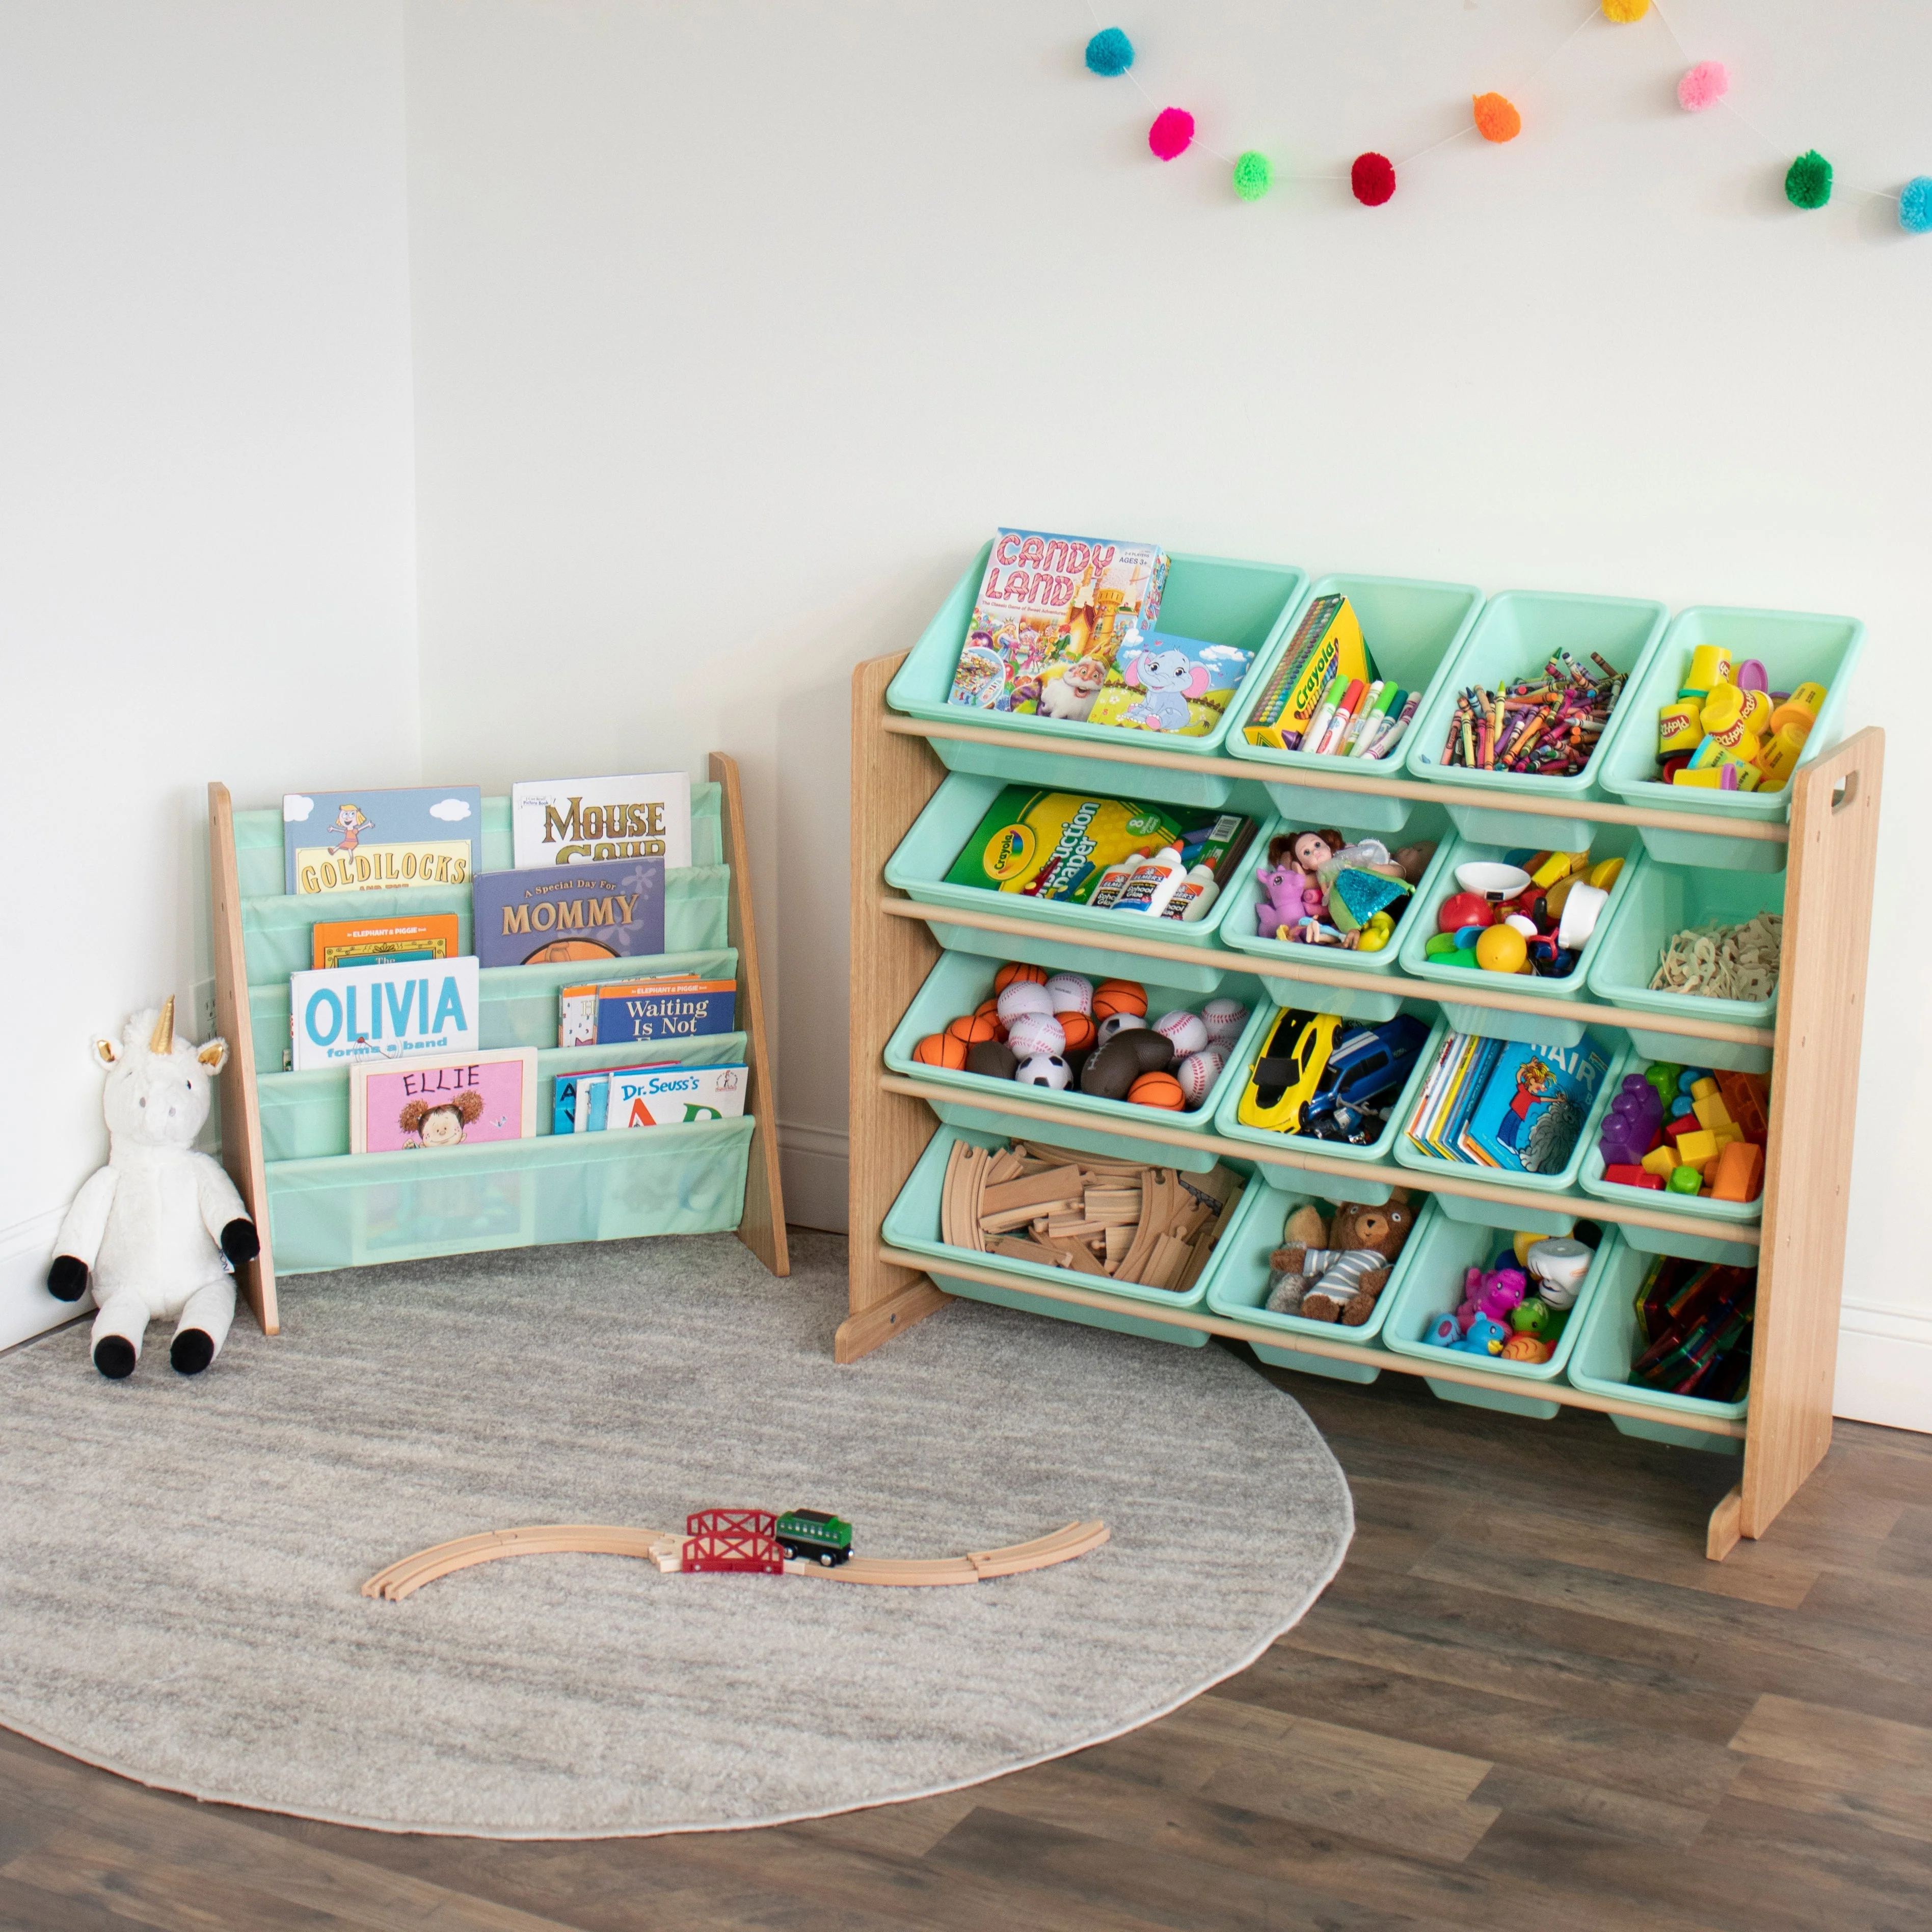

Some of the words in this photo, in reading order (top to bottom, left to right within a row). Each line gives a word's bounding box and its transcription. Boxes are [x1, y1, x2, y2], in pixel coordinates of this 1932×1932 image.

[996, 534, 1115, 577] CANDY
[985, 567, 1075, 607] LAND
[1296, 640, 1334, 710] Crayola
[1711, 721, 1745, 746] Play-Do
[542, 796, 666, 844] MOUSE
[1129, 819, 1144, 828] 8
[994, 834, 1013, 870] Crayola
[1054, 836, 1097, 889] paper
[301, 852, 466, 894] GOLDILOCKS
[524, 890, 533, 898] A
[535, 880, 573, 894] Special
[577, 879, 597, 889] Day
[600, 880, 616, 891] For
[1127, 886, 1154, 894] School
[501, 893, 639, 936] MOMMY
[353, 929, 388, 937] ELEPHANT
[395, 926, 418, 935] PIGGIE
[375, 956, 396, 965] The
[305, 976, 468, 1046] OLIVIA
[626, 998, 710, 1018] Waiting
[633, 1019, 653, 1036] Is
[661, 1016, 697, 1034] Not
[327, 1046, 380, 1058] forms
[387, 1044, 397, 1052] a
[403, 1037, 448, 1051] band
[403, 1065, 480, 1096] ELLIE
[621, 1085, 647, 1101] Dr.
[649, 1076, 700, 1093] Seuss's
